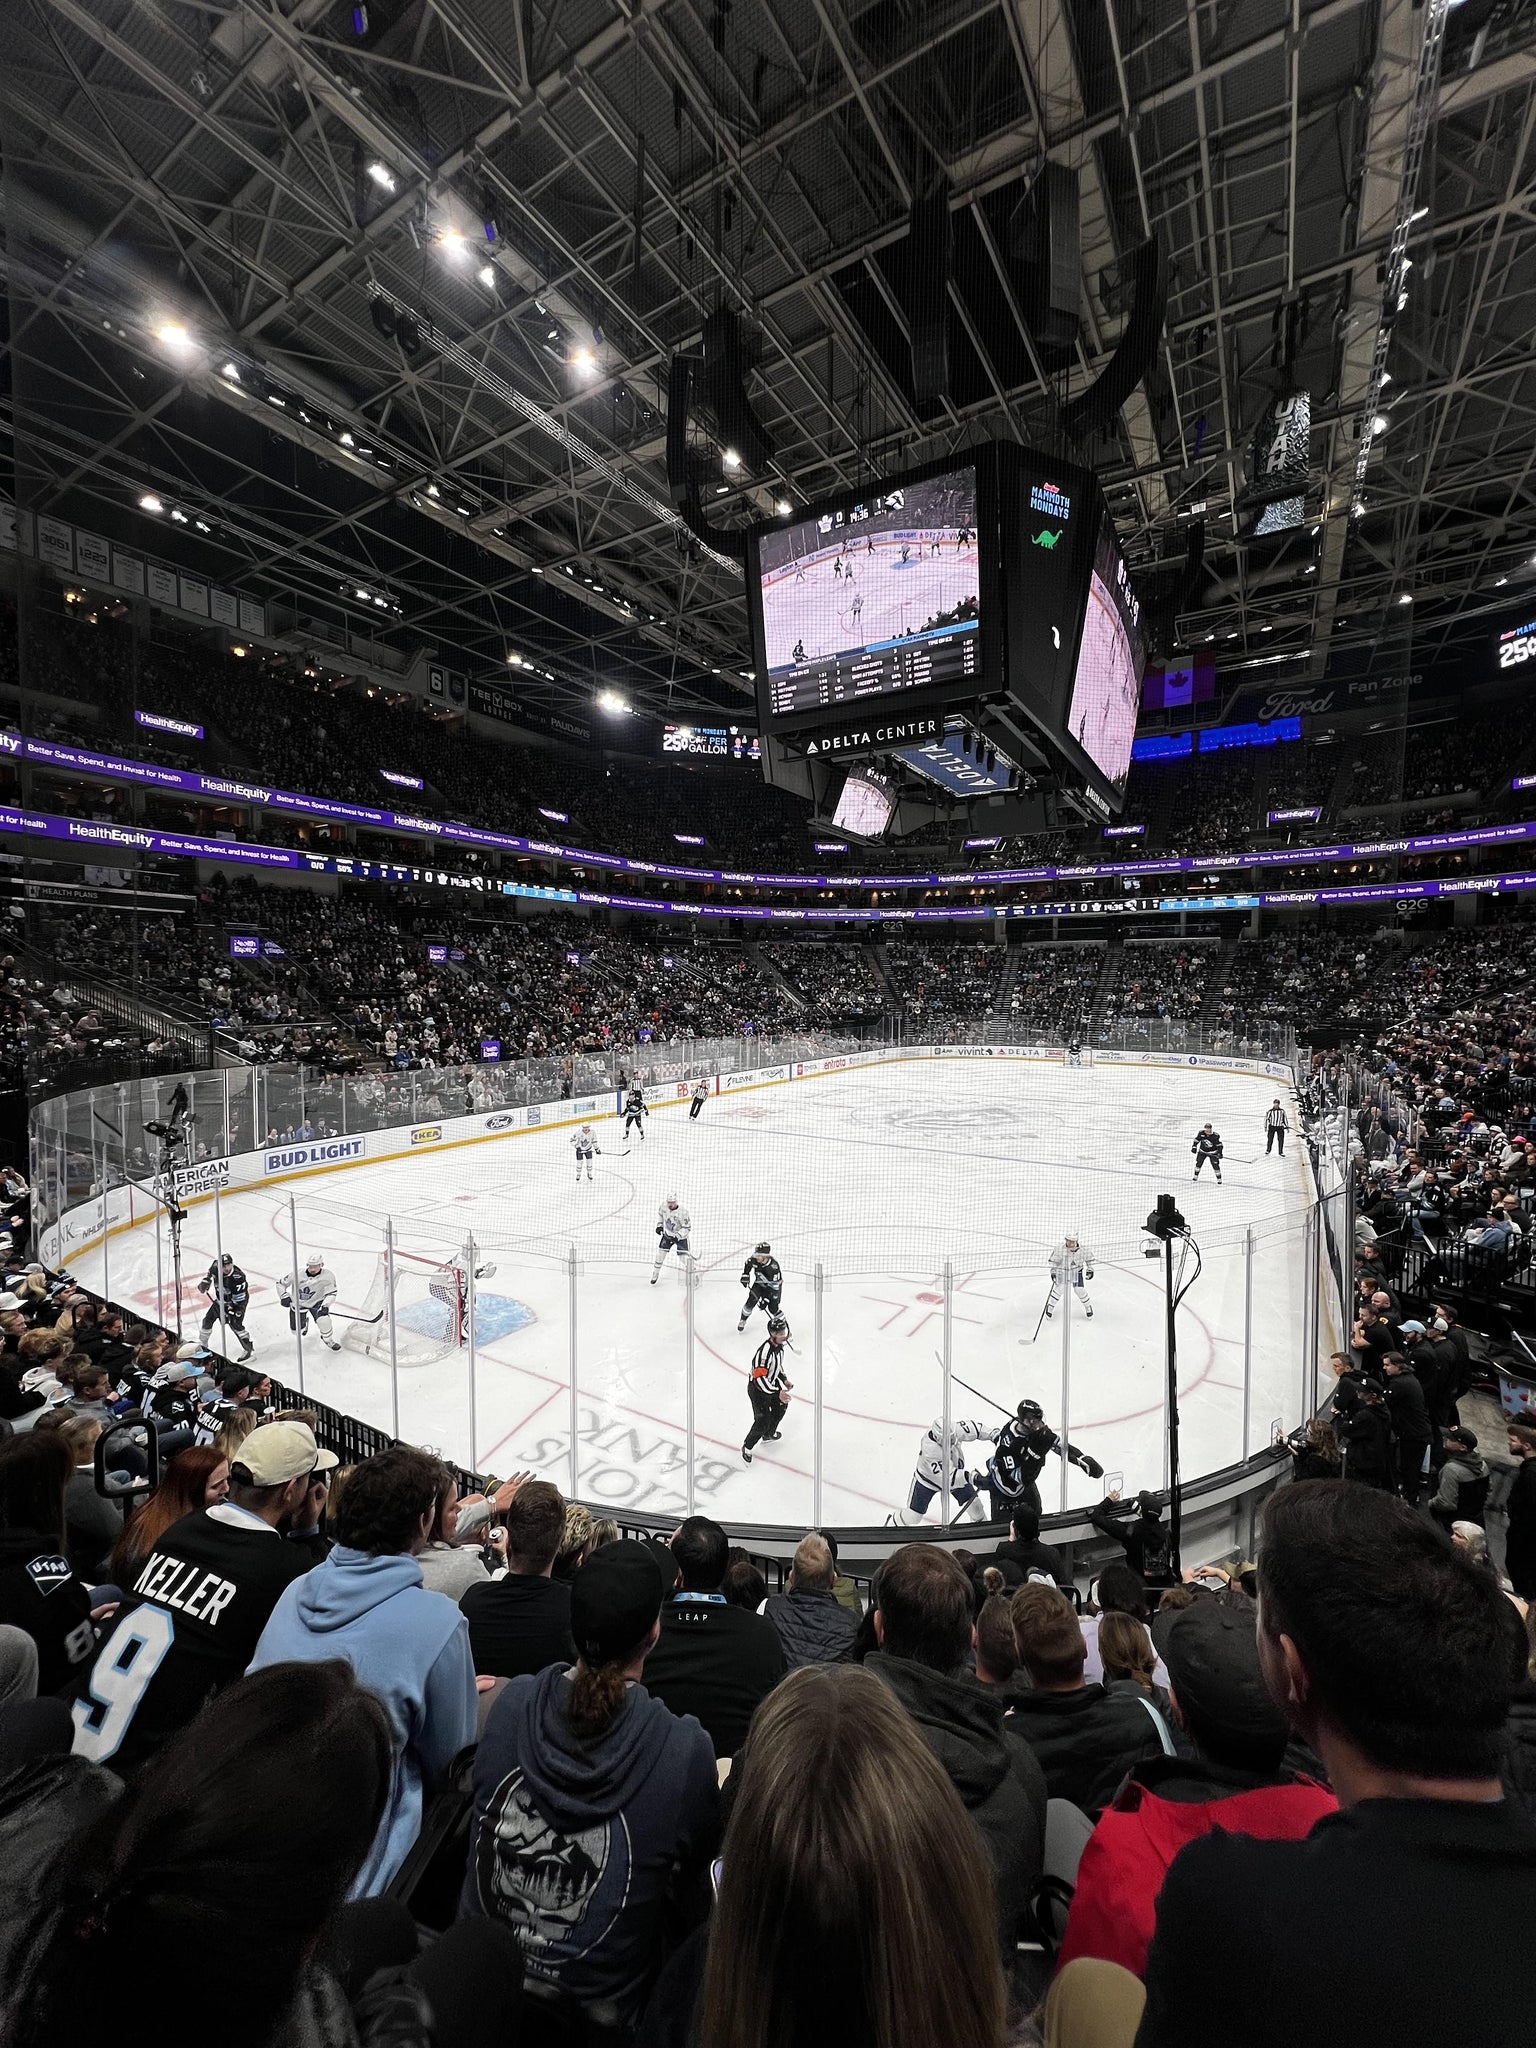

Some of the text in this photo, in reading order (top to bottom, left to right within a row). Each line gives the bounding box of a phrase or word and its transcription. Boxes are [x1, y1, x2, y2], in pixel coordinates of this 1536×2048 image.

[1266, 396, 1297, 474] UTAH
[1031, 486, 1070, 508] MAMMOTH
[836, 512, 843, 522] 0
[850, 508, 869, 523] 14:36
[876, 498, 881, 509] 1
[1030, 497, 1069, 520] MONDAYS
[40, 532, 70, 552] 3051
[79, 546, 107, 565] 1223
[431, 672, 442, 691] 6
[1348, 674, 1424, 694] Fan Zone
[470, 686, 523, 713] TEE BOX
[1257, 688, 1335, 720] Ford
[140, 713, 199, 736] HealthEquity
[822, 720, 936, 750] DELTA CENTER
[663, 733, 689, 752] 25¢
[709, 737, 727, 746] PER
[688, 743, 728, 755] GALLON
[28, 744, 52, 755] Better
[107, 762, 122, 771] and
[123, 765, 145, 776] Invest
[146, 769, 157, 778] for
[158, 771, 182, 783] Health
[918, 743, 982, 780] DELTA
[200, 778, 271, 802] HealthEquity
[276, 794, 295, 804] Better
[341, 806, 358, 815] Invest
[365, 811, 382, 820] Health
[1274, 810, 1315, 820] HealthEquity
[6, 816, 47, 829] for Health
[394, 816, 442, 833] HealthEquity
[69, 823, 154, 848] HealthEquity
[1107, 826, 1141, 834] HealthEquity
[1506, 827, 1526, 835] Health
[161, 839, 183, 849] Better
[228, 848, 241, 856] and
[241, 849, 260, 858] Invest
[270, 853, 290, 862] Health
[528, 841, 563, 856] HealthEquity
[1352, 842, 1409, 854] HealthEquity
[627, 860, 656, 872] HealthEquity
[1192, 857, 1240, 867] HealthEquity
[721, 873, 754, 883] HealthEquity
[1056, 866, 1098, 876] HealthEquity
[425, 872, 433, 882] 0
[450, 877, 470, 888] 14:36
[487, 880, 492, 890] 1
[827, 877, 862, 887] HealthEquity
[938, 874, 975, 884] HealthEquity
[1439, 879, 1499, 892] HealthEquity
[41, 887, 98, 899] HEALTH PLANS
[579, 892, 610, 905] HealthEquity
[1265, 893, 1317, 904] HealthEquity
[671, 903, 702, 914] HealthEquity
[1081, 903, 1088, 911] 0
[1104, 903, 1123, 911] 14:36
[1396, 898, 1428, 911] G2G
[771, 910, 805, 919] HealthEquity
[879, 910, 915, 919] HealthEquity
[957, 1047, 984, 1056] vivint
[1008, 1048, 1040, 1056] DELTA
[824, 1059, 846, 1070] entrata
[413, 1130, 439, 1140] IKEA
[268, 1141, 361, 1170] BUD LIGHT
[51, 1222, 76, 1258] BNK
[235, 1282, 246, 1293] 77
[566, 1407, 745, 1493] BANK
[1003, 1455, 1015, 1470] 19
[32, 1560, 69, 1574] UTAH
[133, 1552, 236, 1626] KELLER
[678, 1613, 708, 1621] LEAP
[70, 1602, 175, 1765] 9
